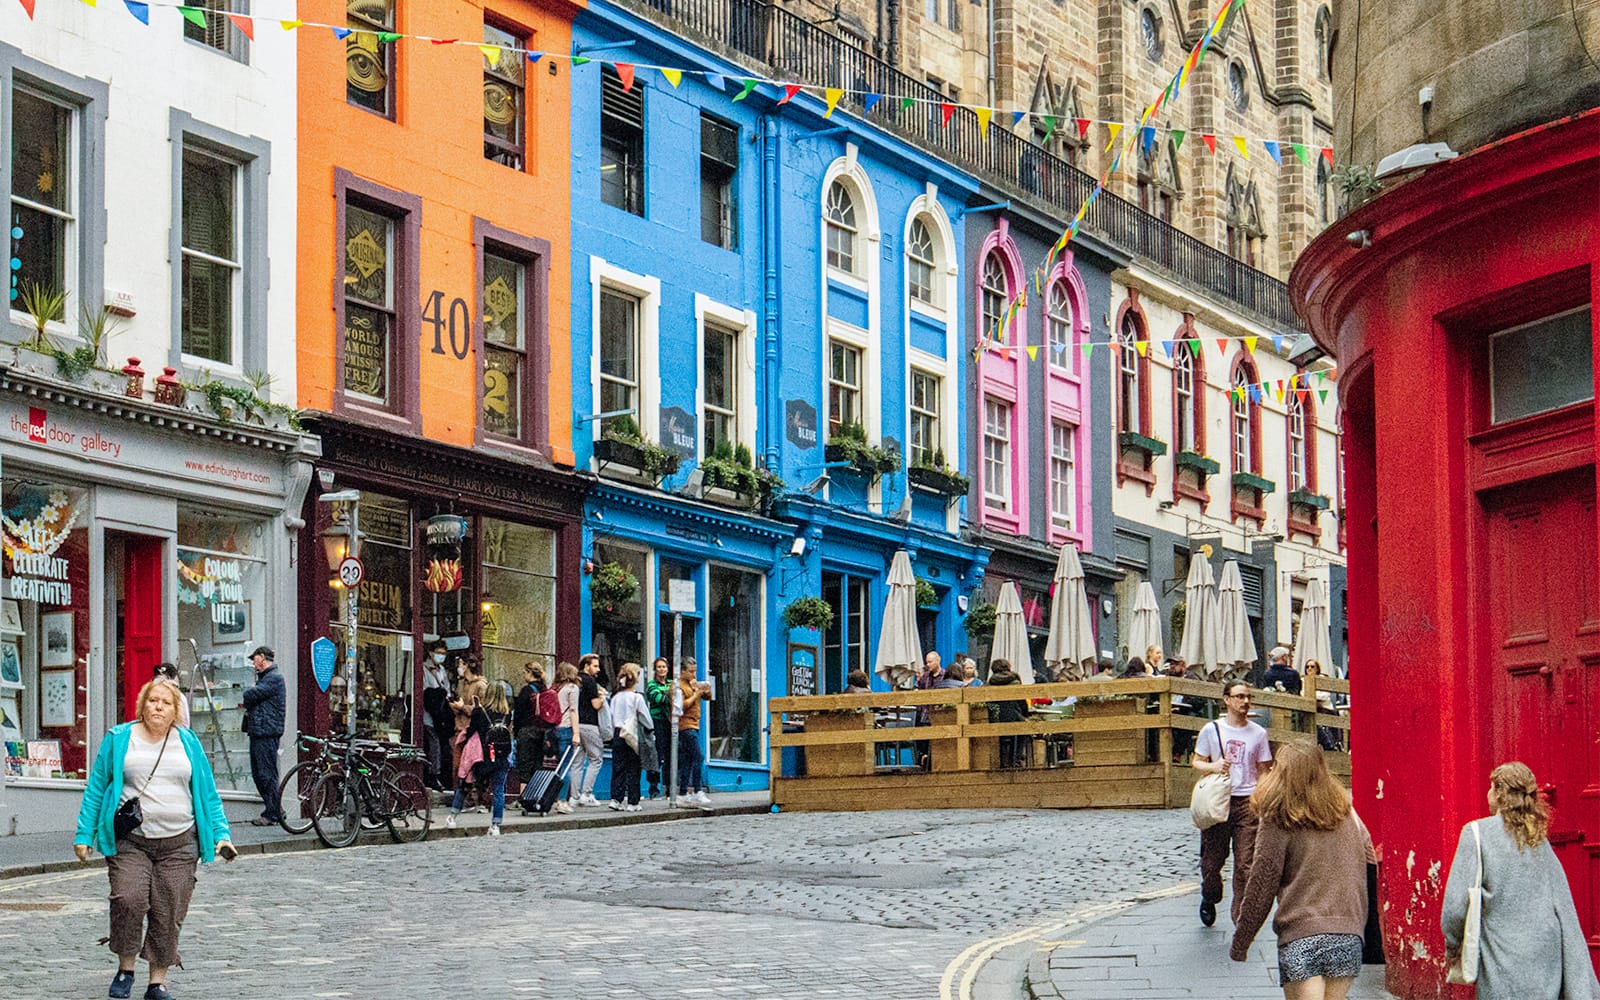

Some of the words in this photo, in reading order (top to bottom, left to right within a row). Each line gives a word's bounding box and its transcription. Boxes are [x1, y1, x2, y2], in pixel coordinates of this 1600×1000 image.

[422, 290, 470, 360] 40
[345, 340, 380, 358] AMOUS
[10, 414, 28, 434] the
[29, 420, 46, 438] red
[48, 423, 76, 444] door
[80, 432, 121, 458] gallery
[673, 432, 694, 449] BLEUE
[184, 460, 271, 484] www.edinburghart.com
[13, 549, 69, 580] CELEBRATE
[342, 566, 361, 580] 20
[220, 580, 245, 604] YOUR
[211, 602, 236, 626] LIFE!
